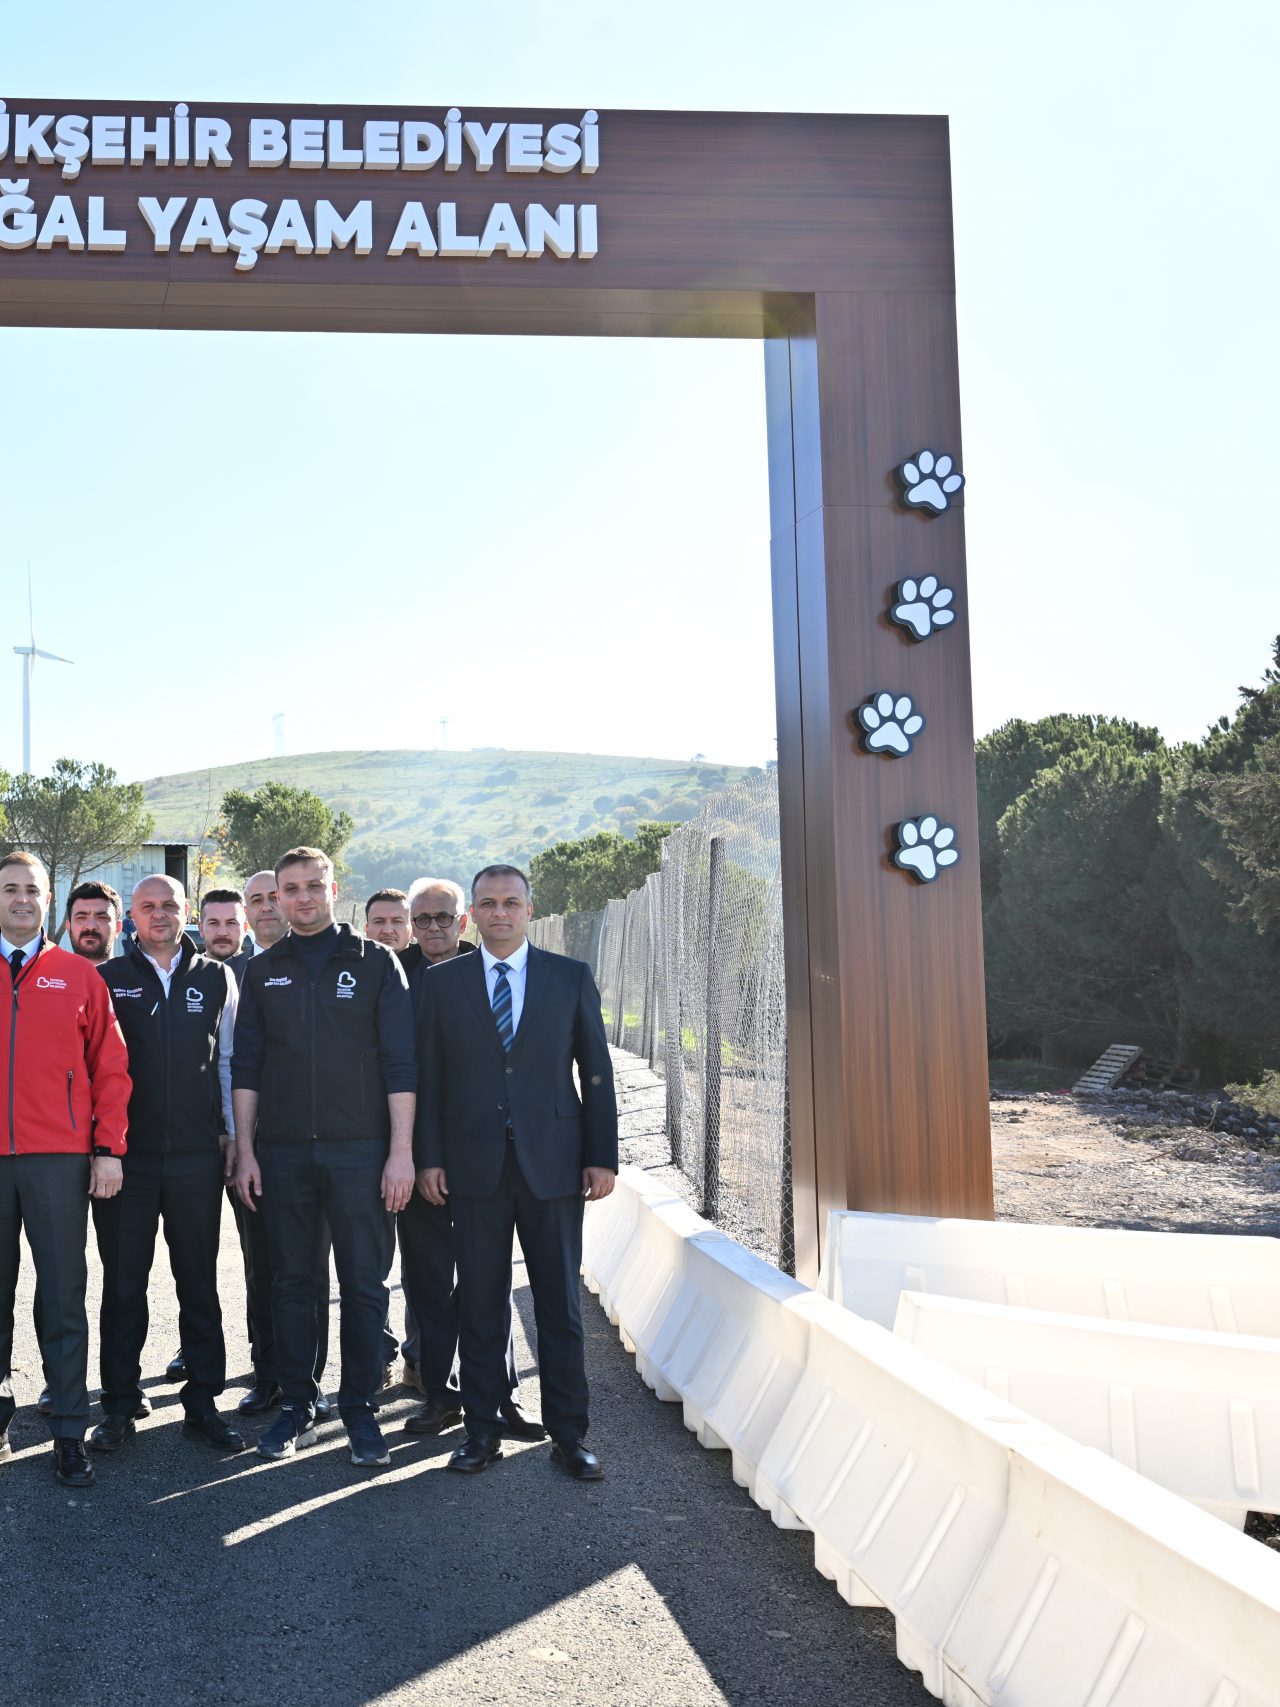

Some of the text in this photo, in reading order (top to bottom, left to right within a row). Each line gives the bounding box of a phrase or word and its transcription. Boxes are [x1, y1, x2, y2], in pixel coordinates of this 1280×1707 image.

[248, 107, 599, 174] BELEDİYESİ
[137, 195, 372, 271] YAŞAM
[386, 201, 598, 259] ALANI
